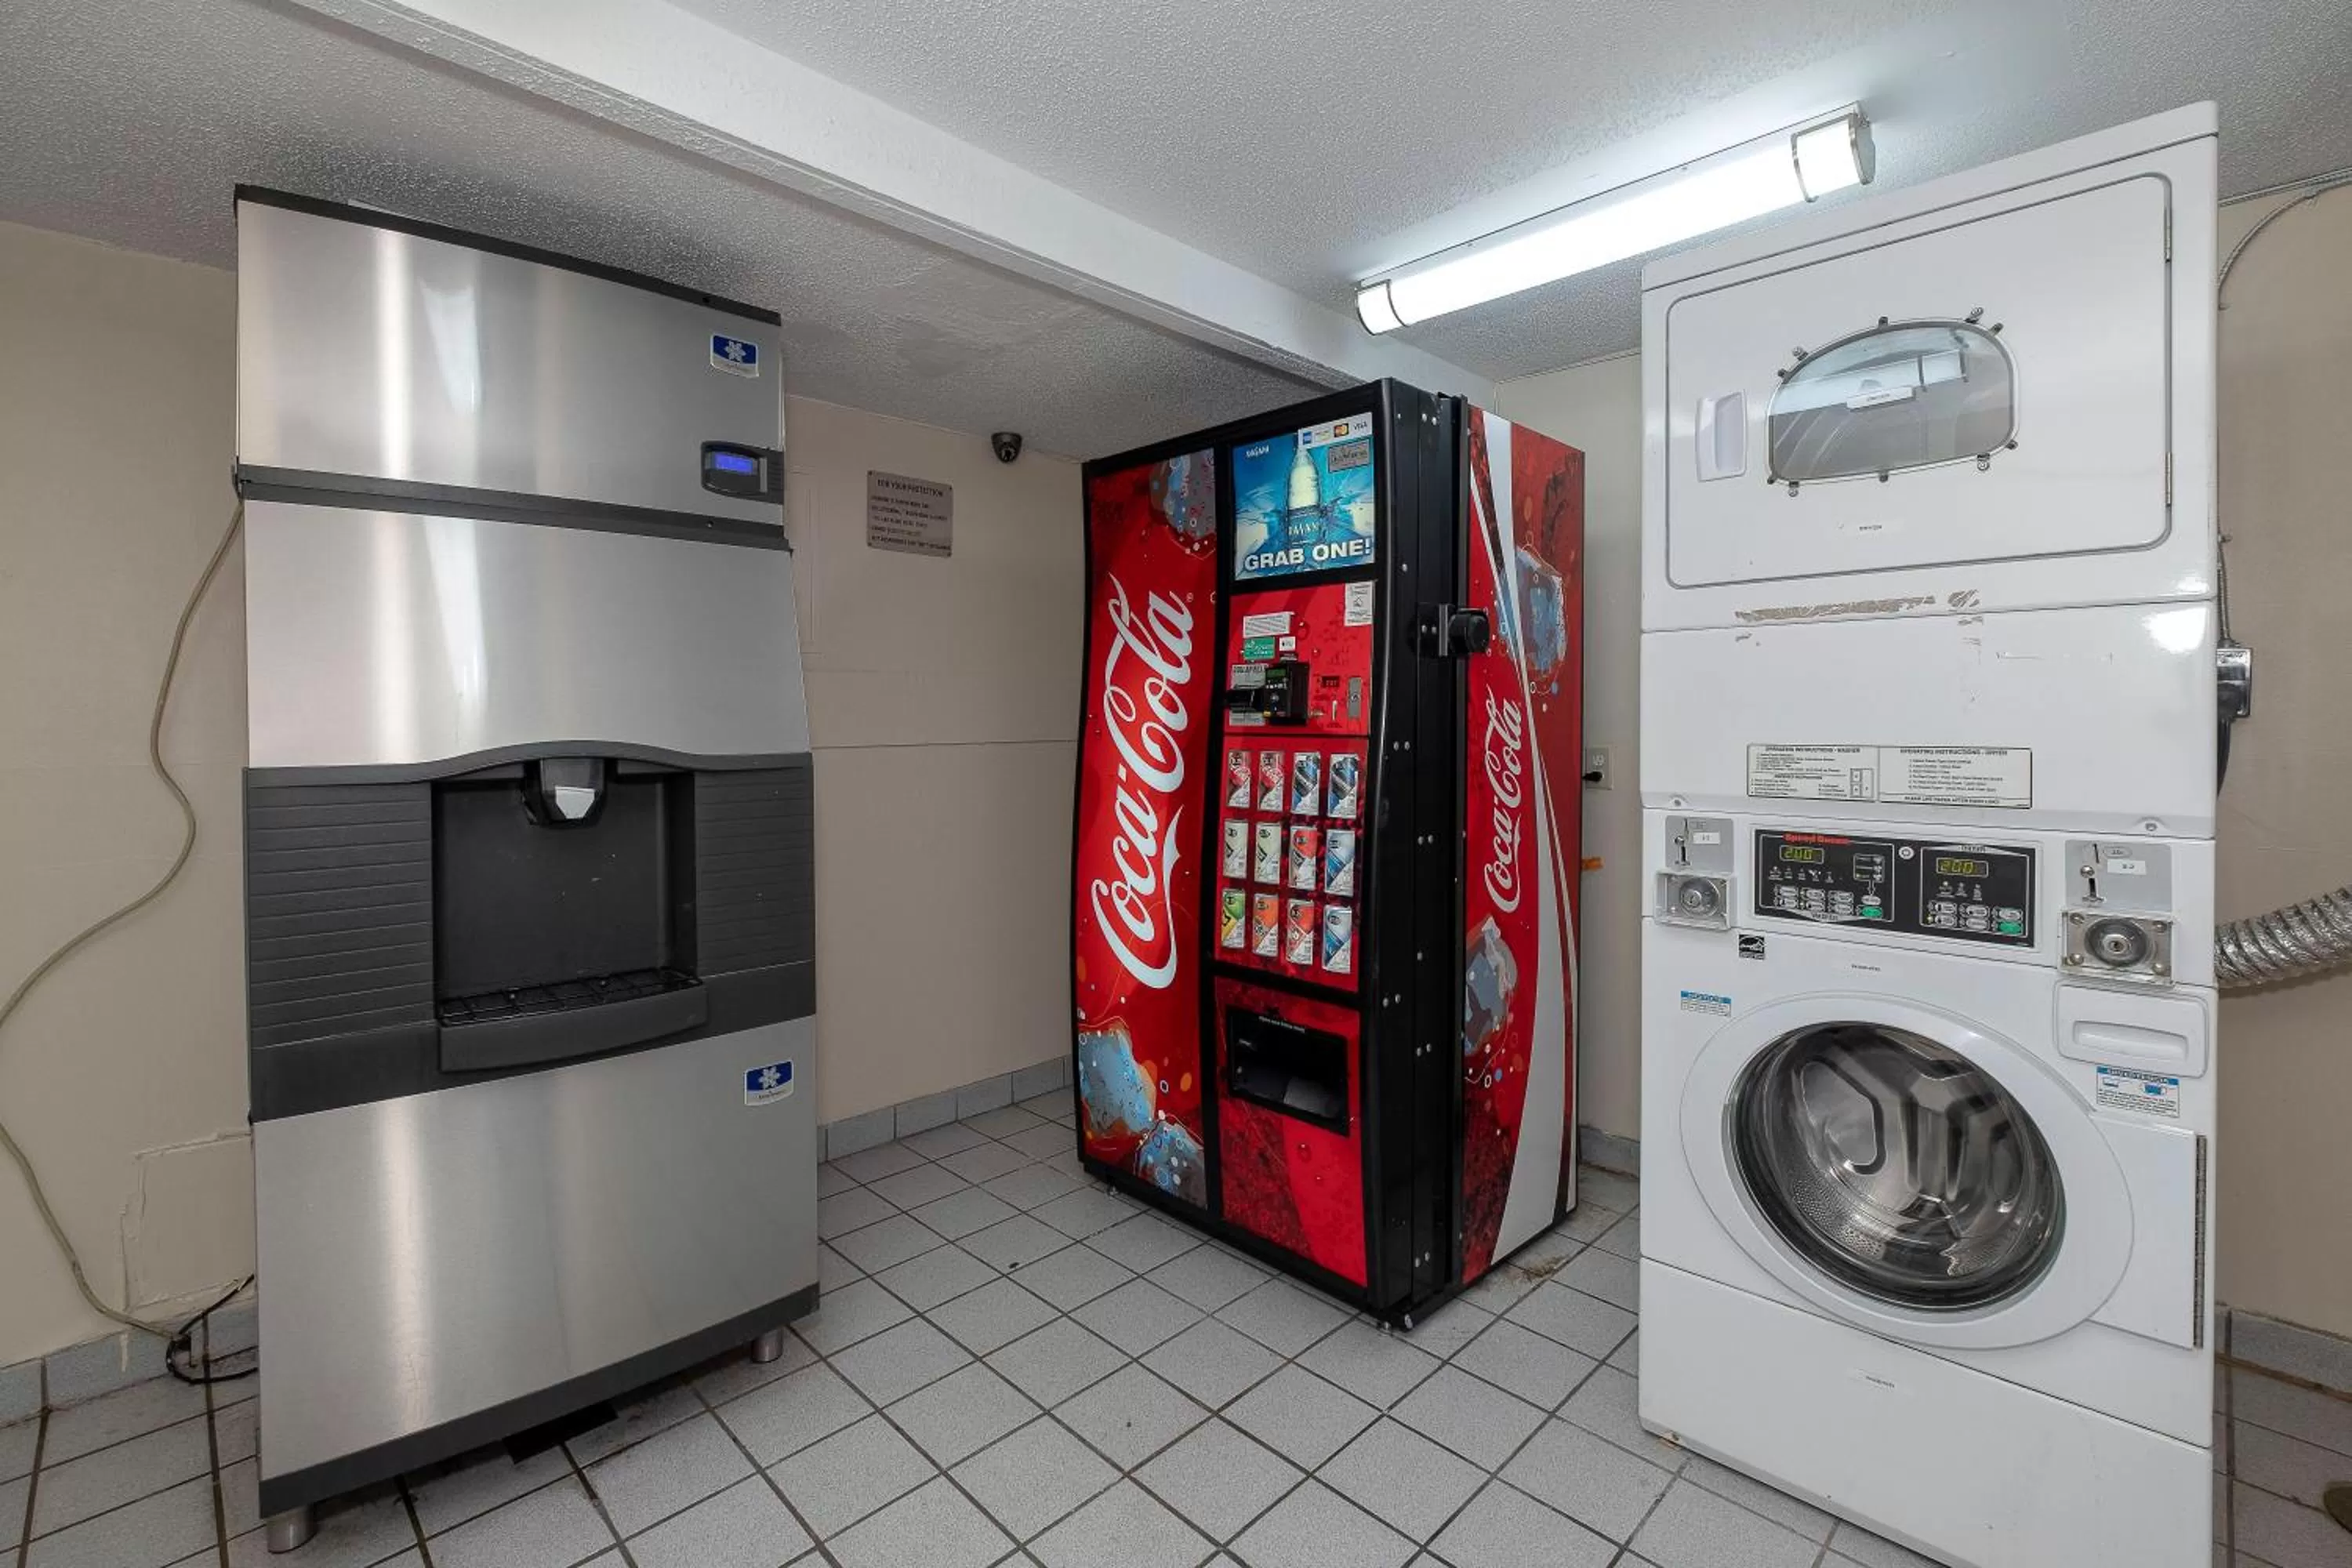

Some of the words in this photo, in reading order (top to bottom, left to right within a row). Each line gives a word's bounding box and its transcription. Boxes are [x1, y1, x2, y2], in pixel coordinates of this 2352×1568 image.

[1244, 548, 1305, 572] GRAB
[1312, 538, 1371, 561] ONE!
[1091, 572, 1195, 989] Coca-Cola
[1484, 684, 1522, 913] Coca-Cola
